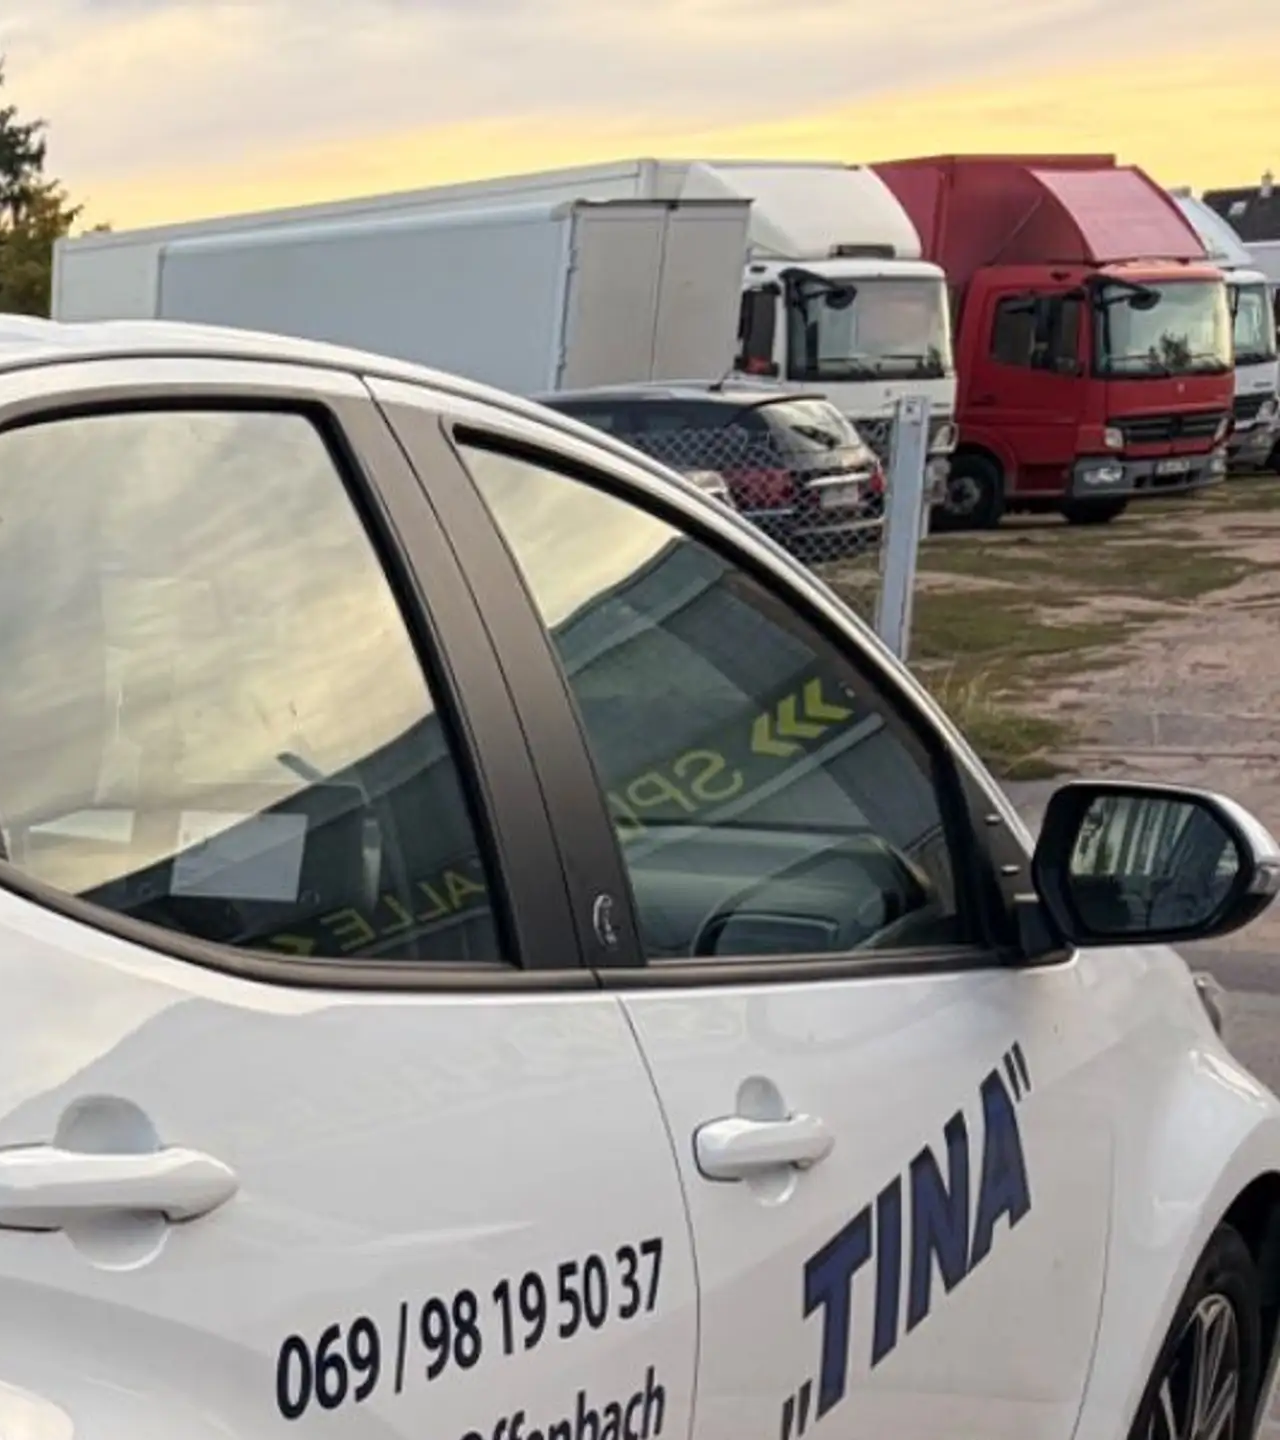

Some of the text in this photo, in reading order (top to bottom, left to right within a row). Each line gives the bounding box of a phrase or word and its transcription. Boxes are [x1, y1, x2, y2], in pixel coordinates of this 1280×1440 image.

[275, 1315, 381, 1421] 069
[419, 1288, 483, 1382] 98
[491, 1270, 548, 1356] 19
[557, 1253, 609, 1340] 50
[614, 1236, 664, 1320] 37
